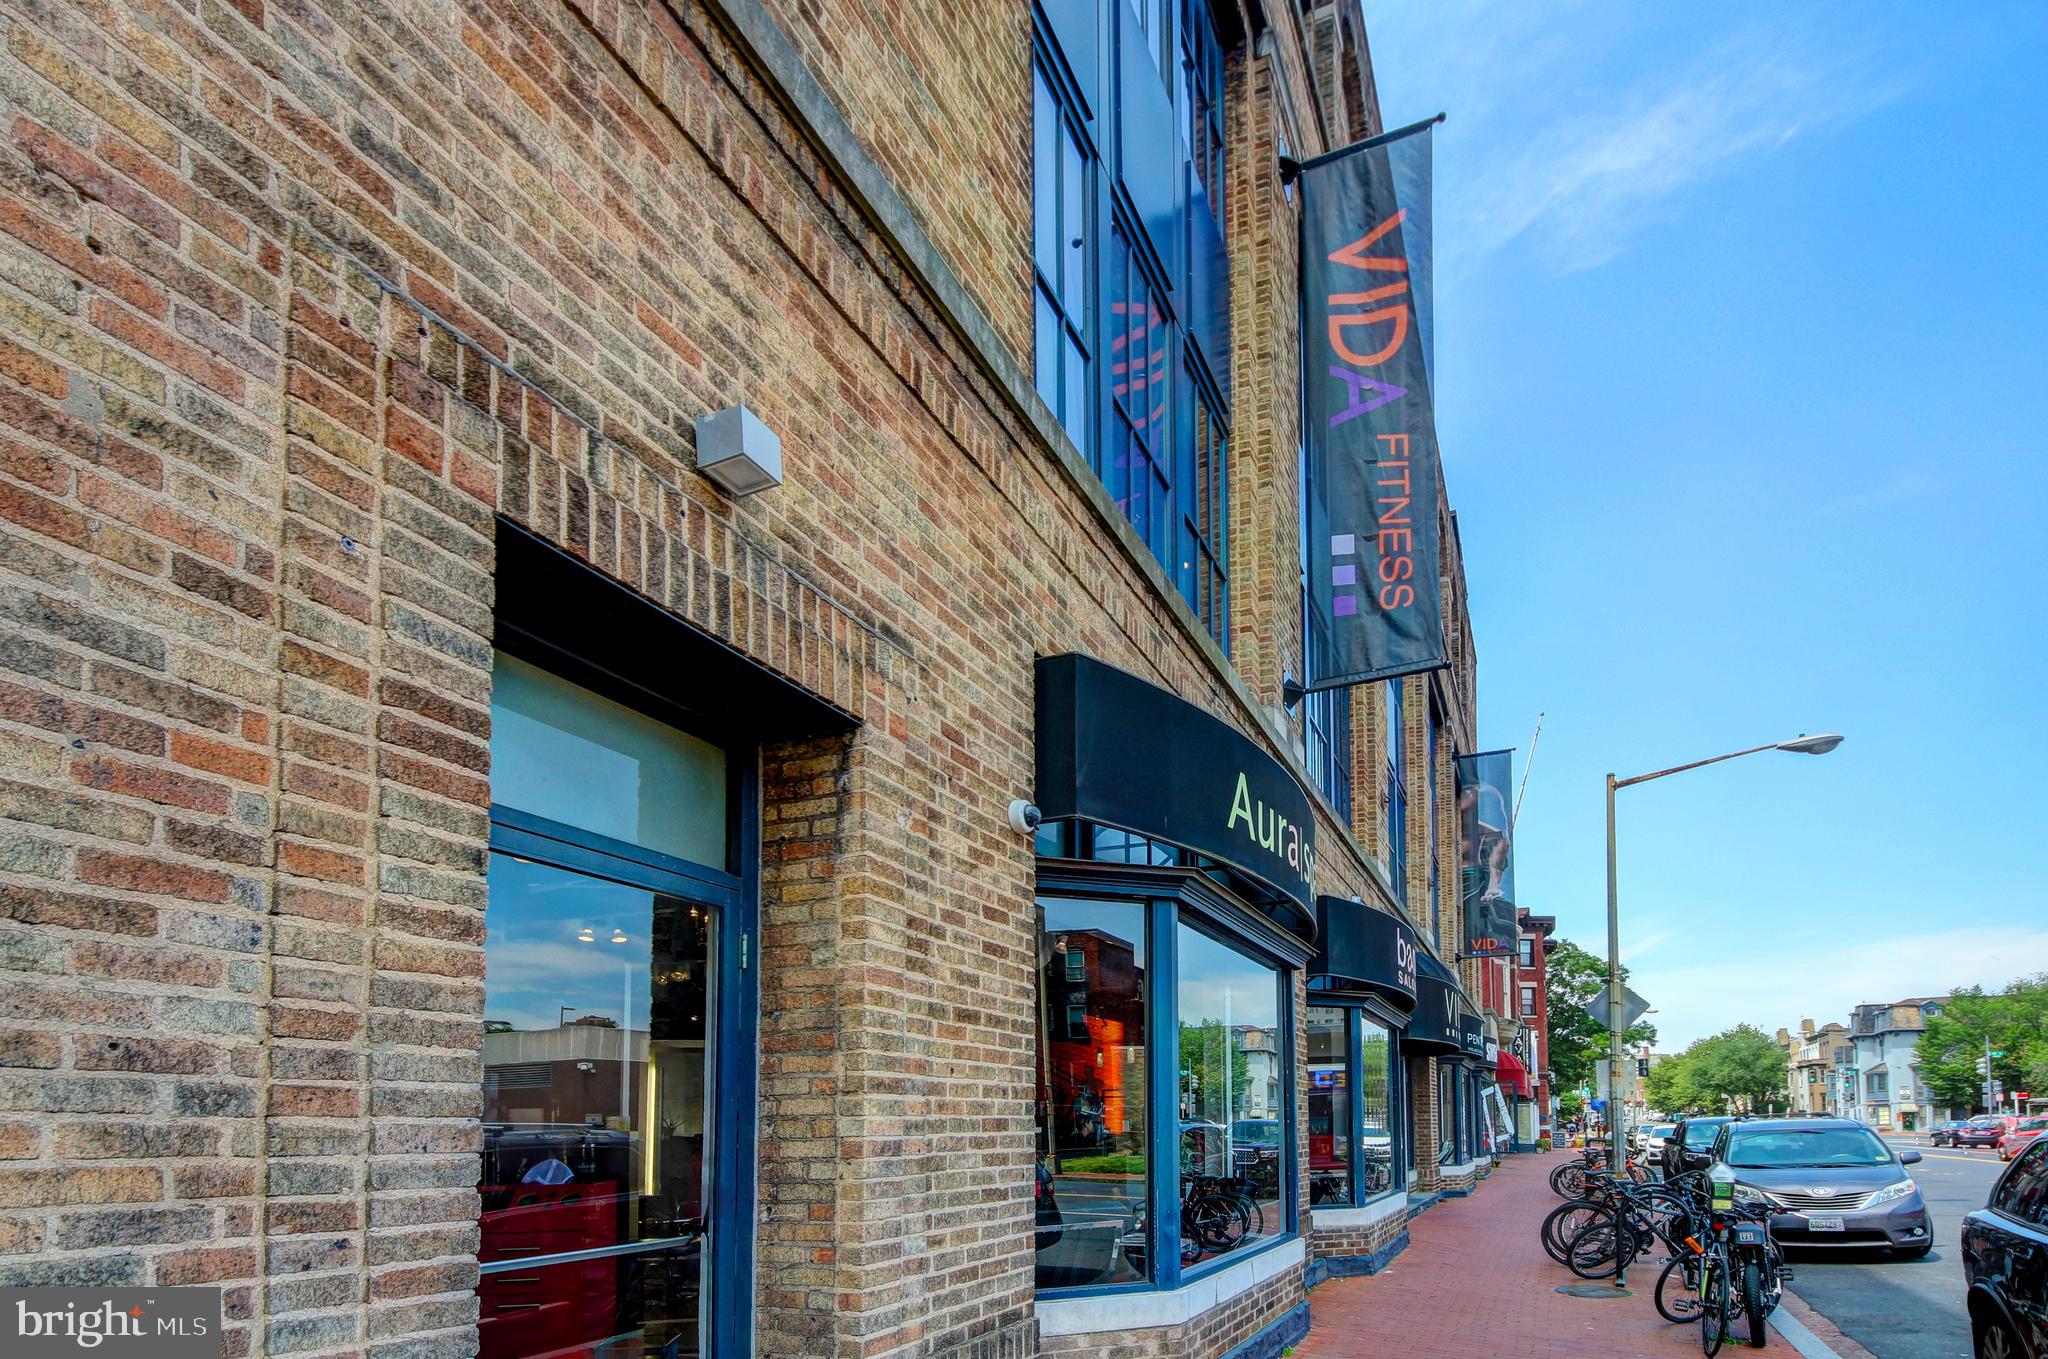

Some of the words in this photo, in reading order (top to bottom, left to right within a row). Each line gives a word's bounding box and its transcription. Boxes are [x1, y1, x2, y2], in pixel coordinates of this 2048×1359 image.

[1327, 208, 1409, 427] VIDA
[1376, 433, 1414, 610] FITNESS
[1471, 937, 1510, 951] VIDA
